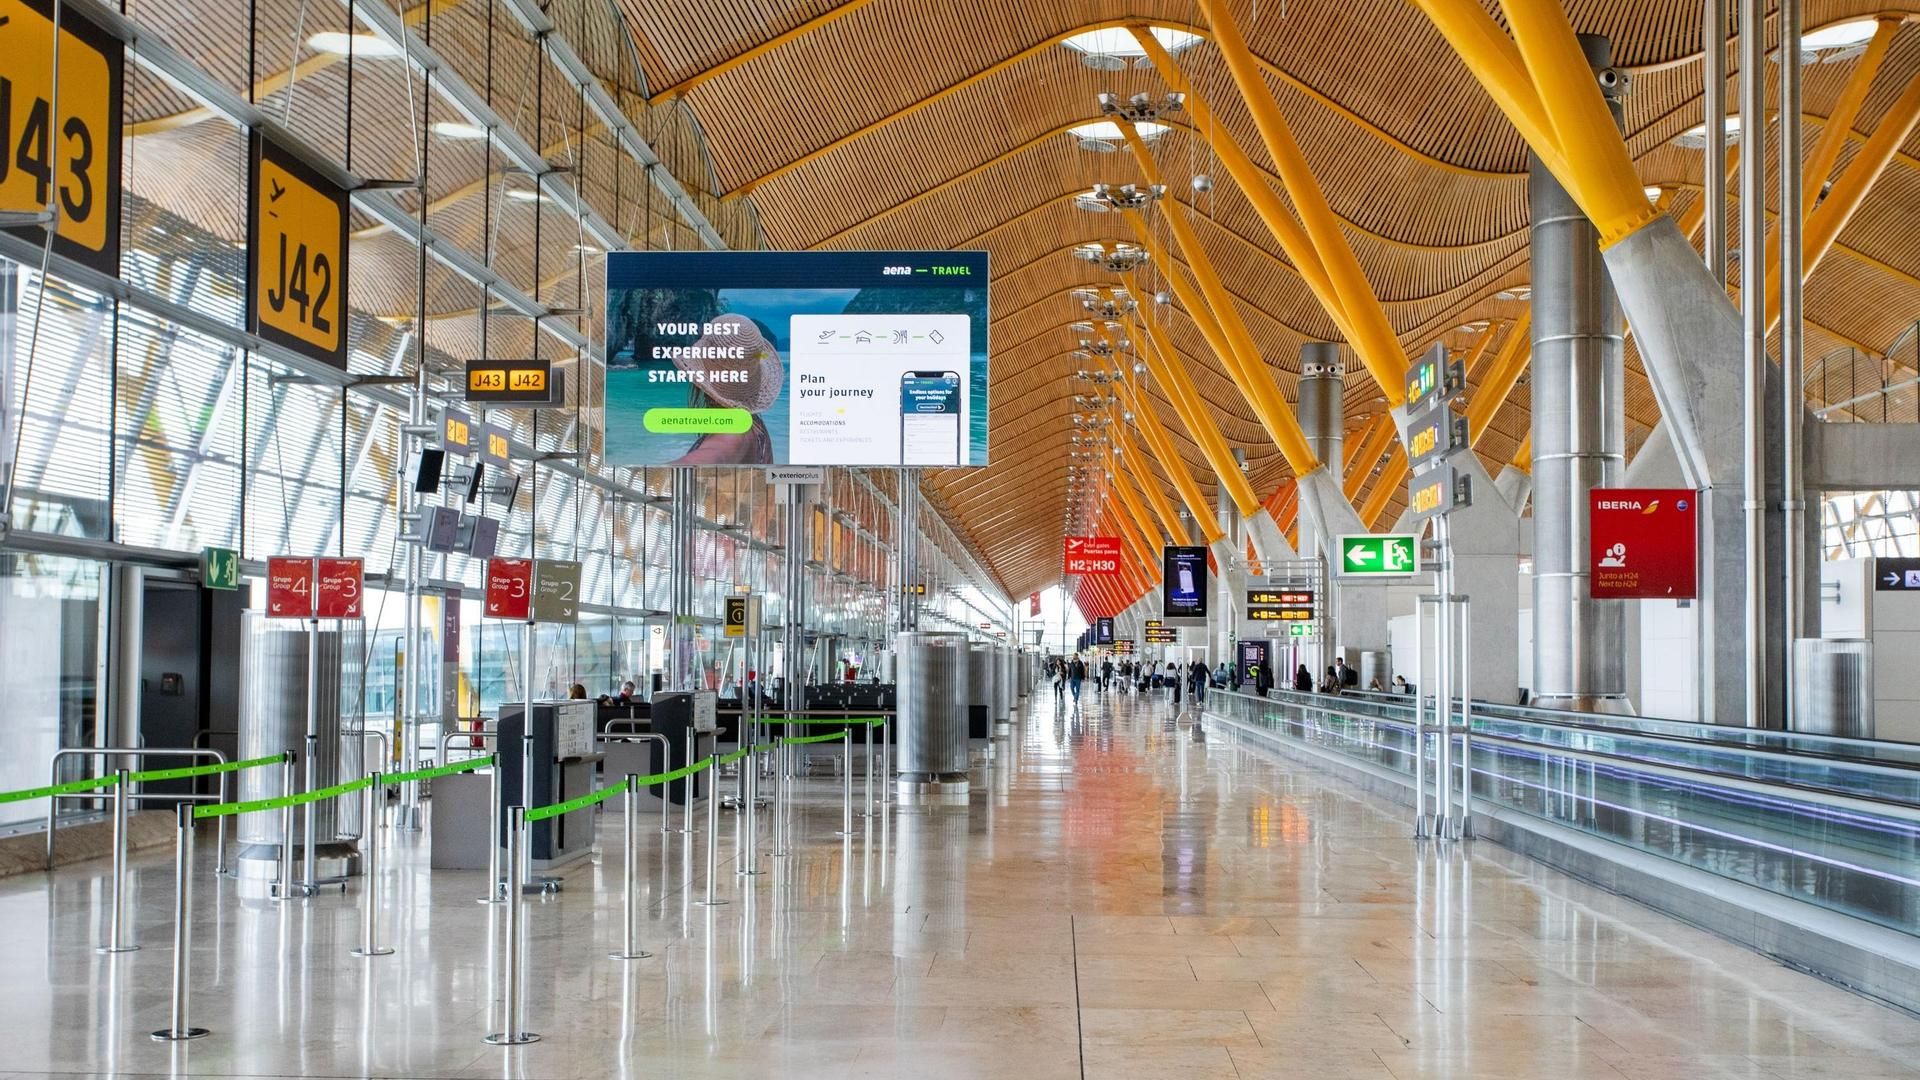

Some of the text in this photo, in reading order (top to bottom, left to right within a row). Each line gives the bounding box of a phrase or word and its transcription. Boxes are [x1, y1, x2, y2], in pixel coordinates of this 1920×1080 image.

[883, 266, 971, 275] aena TRAVEL
[268, 232, 331, 335] J42
[657, 323, 741, 335] YOUR BEST
[652, 346, 745, 359] EXPERIENCE
[474, 374, 501, 387] J43
[514, 374, 540, 387] J42
[648, 370, 748, 383] STARTS HERE
[800, 374, 825, 383] Plan
[800, 387, 874, 399] your journey
[661, 416, 734, 425] aenatravel.com
[779, 472, 819, 480] exteriorplus
[1598, 501, 1642, 509] IBERIA
[1070, 560, 1085, 570] H2
[1093, 560, 1116, 570] H30
[292, 576, 308, 596] 4
[492, 576, 511, 584] Grupo
[343, 577, 357, 597] 3
[511, 577, 525, 598] 3
[560, 581, 574, 601] 2
